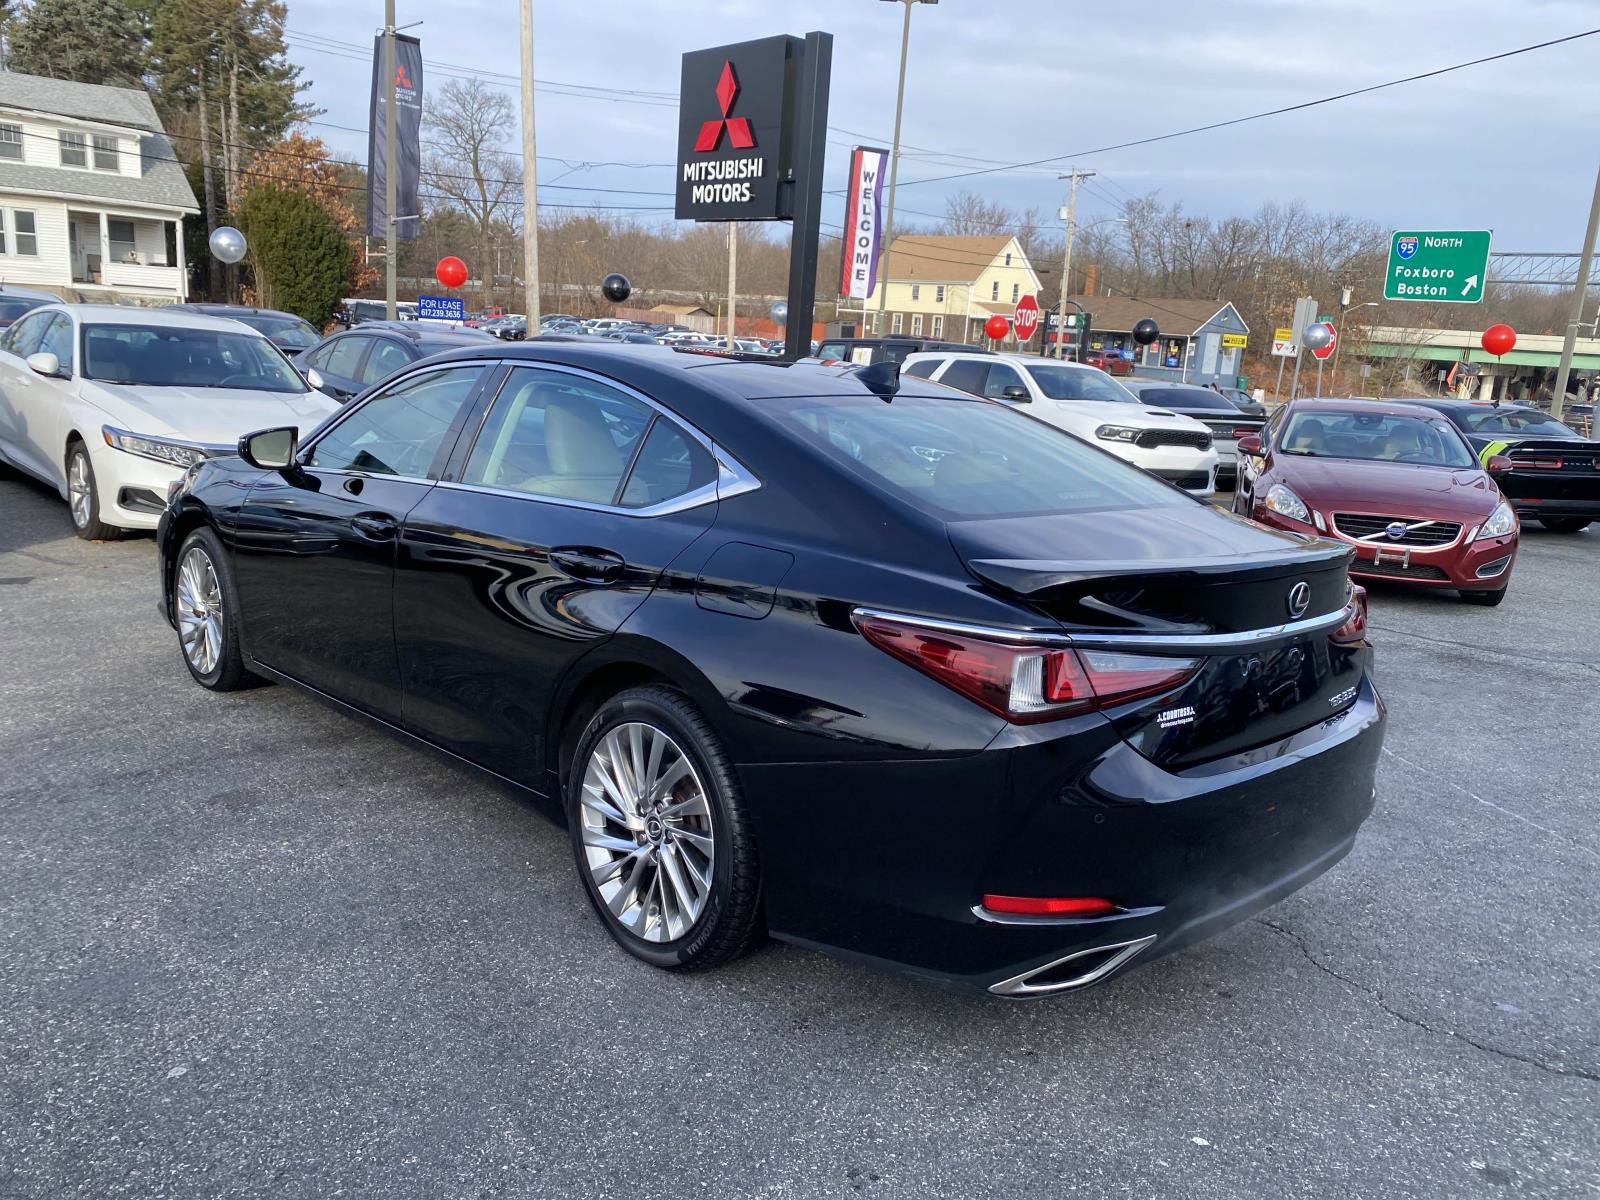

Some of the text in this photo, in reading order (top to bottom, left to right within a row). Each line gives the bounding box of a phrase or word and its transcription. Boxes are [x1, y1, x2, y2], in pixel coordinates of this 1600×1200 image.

[683, 157, 763, 182] MITSUBISHI
[692, 182, 751, 204] MOTORS
[855, 170, 875, 281] WELCOME
[1400, 243, 1415, 254] 95
[1424, 236, 1463, 248] NORTH
[1395, 265, 1455, 278] Foxboro
[1397, 283, 1447, 296] Boston
[420, 299, 462, 310] FOR LEASE
[421, 309, 461, 318] 617.239.3636
[1015, 308, 1037, 327] STOP
